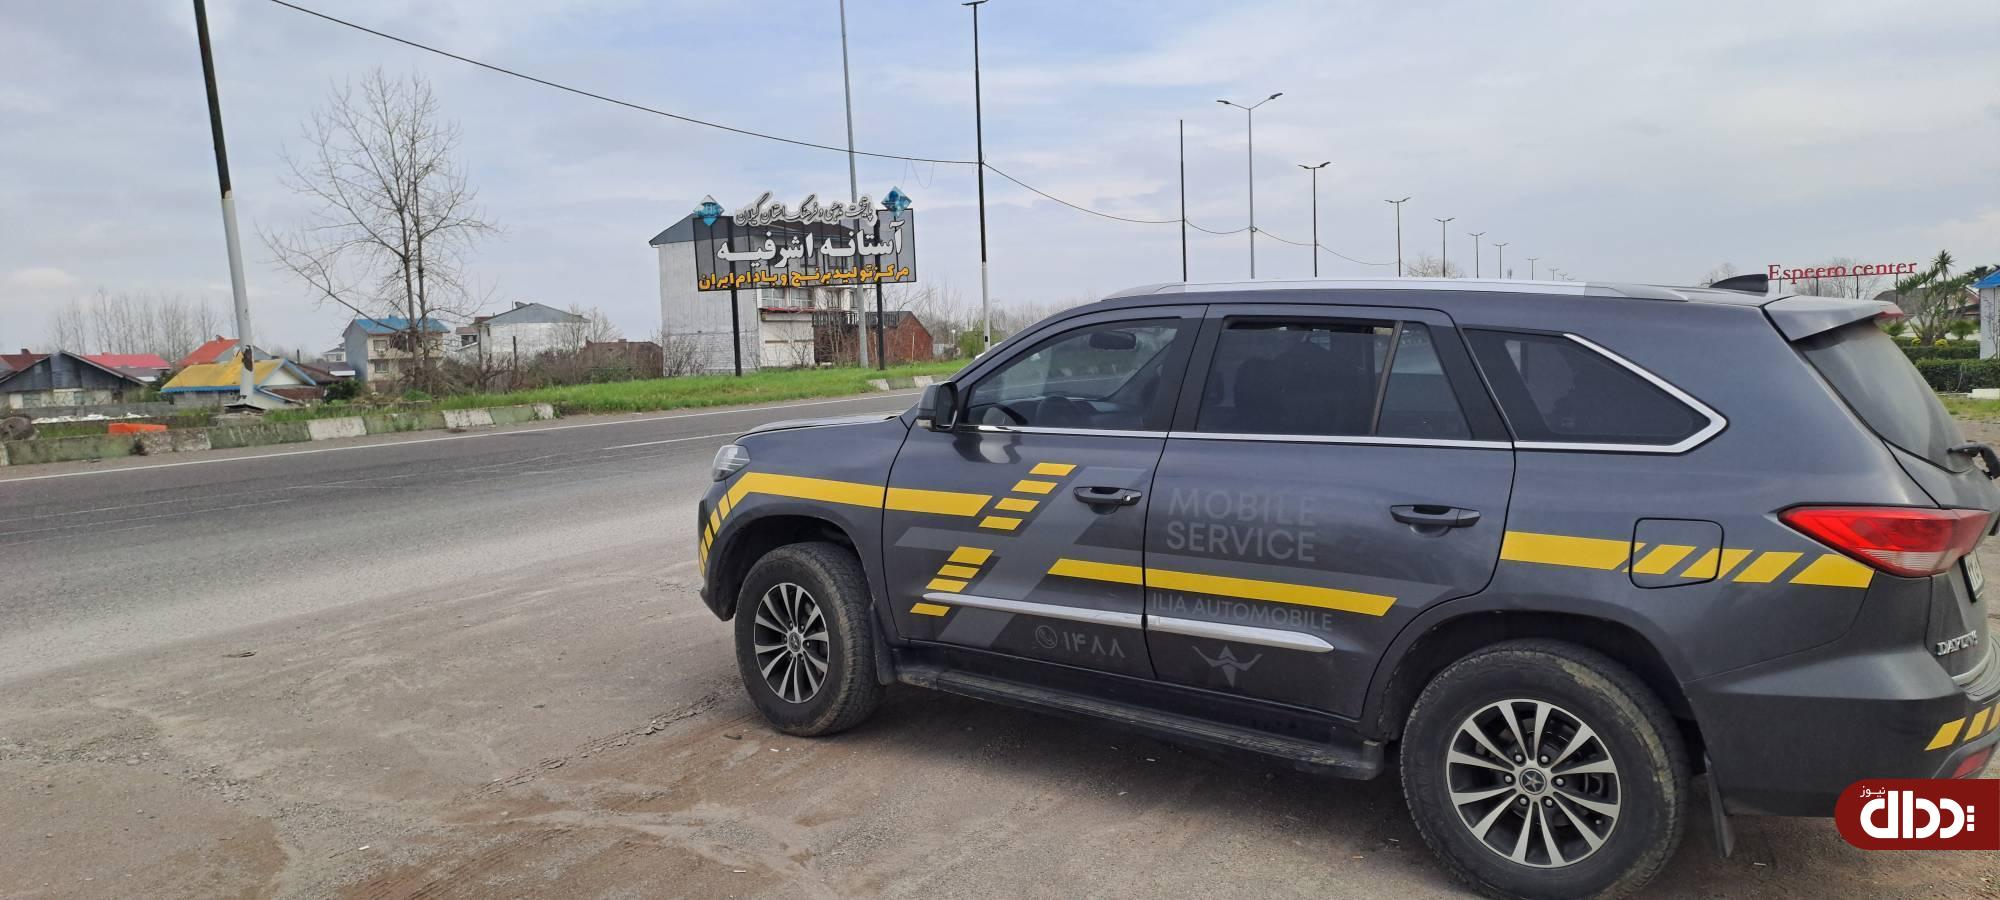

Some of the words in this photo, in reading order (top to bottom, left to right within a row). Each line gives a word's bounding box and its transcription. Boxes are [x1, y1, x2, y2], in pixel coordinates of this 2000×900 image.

[735, 191, 771, 225] گیلان
[717, 231, 814, 268] اشرفیه
[820, 220, 905, 257] آستانه
[699, 271, 735, 290] ایران
[735, 270, 779, 288] بادام
[790, 267, 832, 288] برنج
[831, 264, 874, 284] تولید
[872, 263, 910, 283] مرکز
[1767, 264, 1847, 285] Espeero
[1852, 262, 1918, 276] center
[1168, 487, 1317, 526] MOBILE
[1166, 521, 1317, 562] SERVICE
[1153, 593, 1187, 612] ILIA
[1191, 600, 1333, 632] AUTOMOBILE
